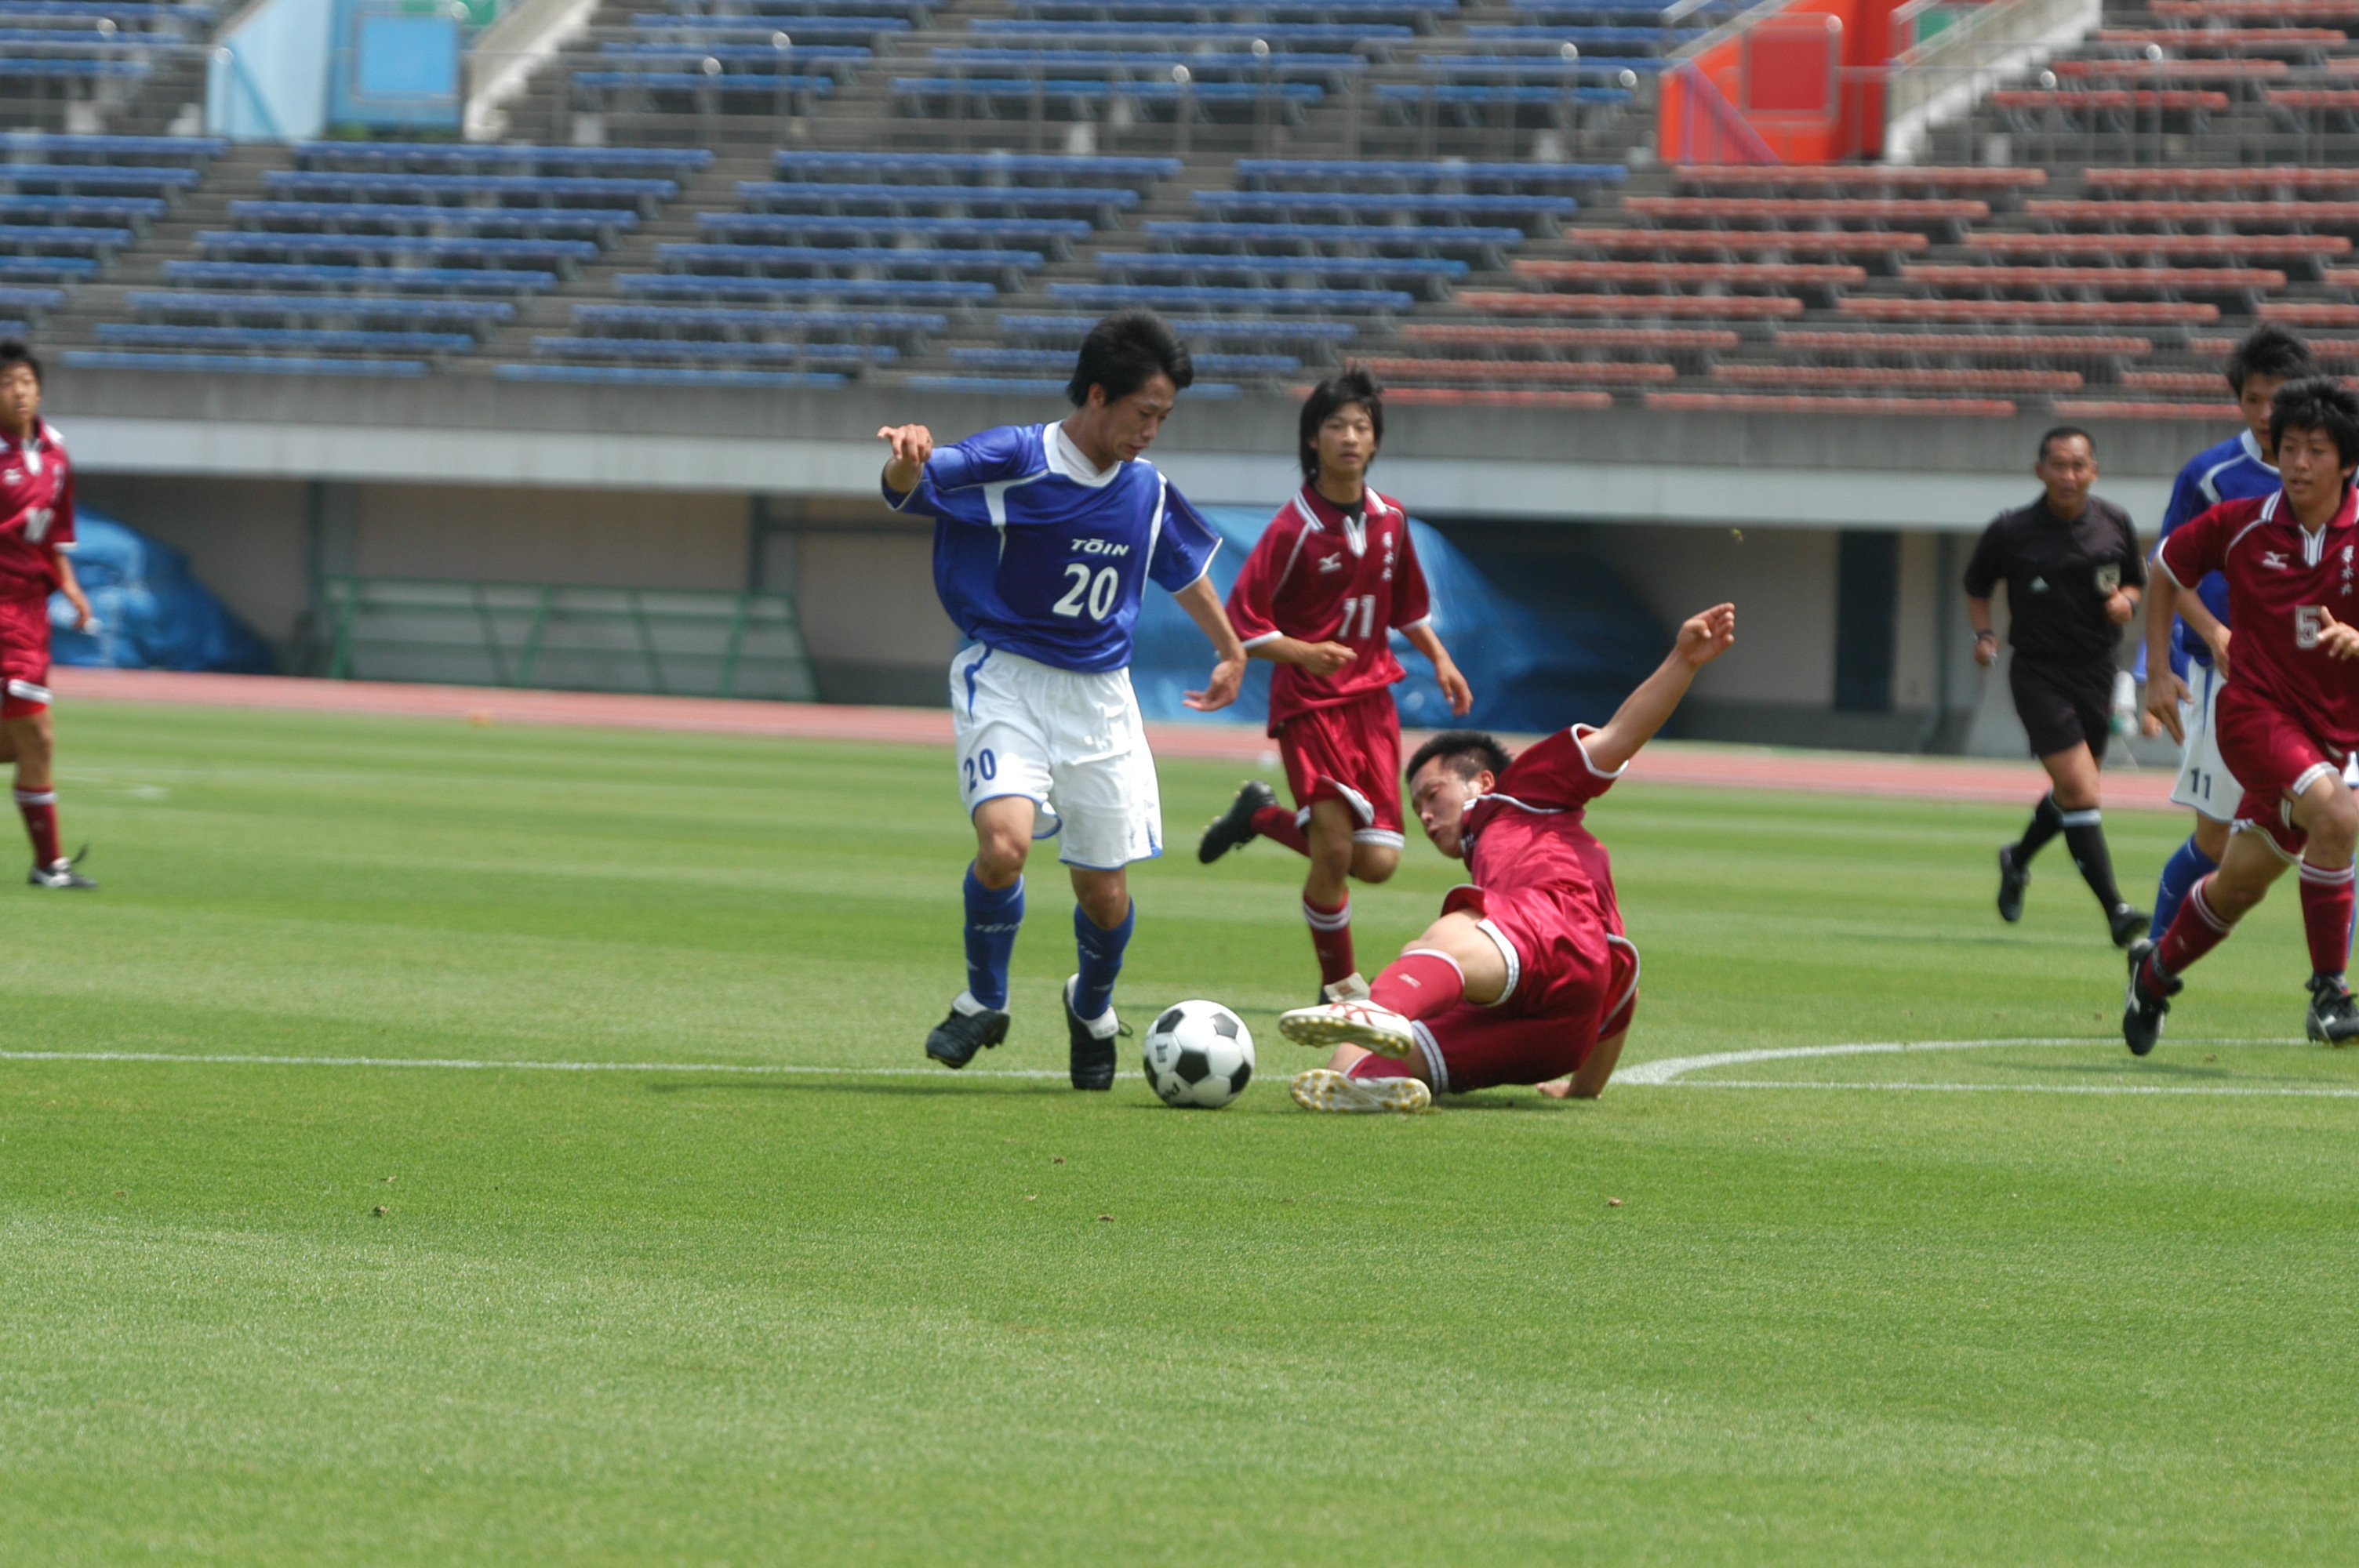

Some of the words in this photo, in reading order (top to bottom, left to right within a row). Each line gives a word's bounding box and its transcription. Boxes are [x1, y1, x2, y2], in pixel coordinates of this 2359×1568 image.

[1052, 562, 1119, 621] 20
[1338, 594, 1376, 639] 11
[2295, 604, 2321, 648] 5
[964, 748, 997, 792] 20
[2190, 768, 2212, 800] 11
